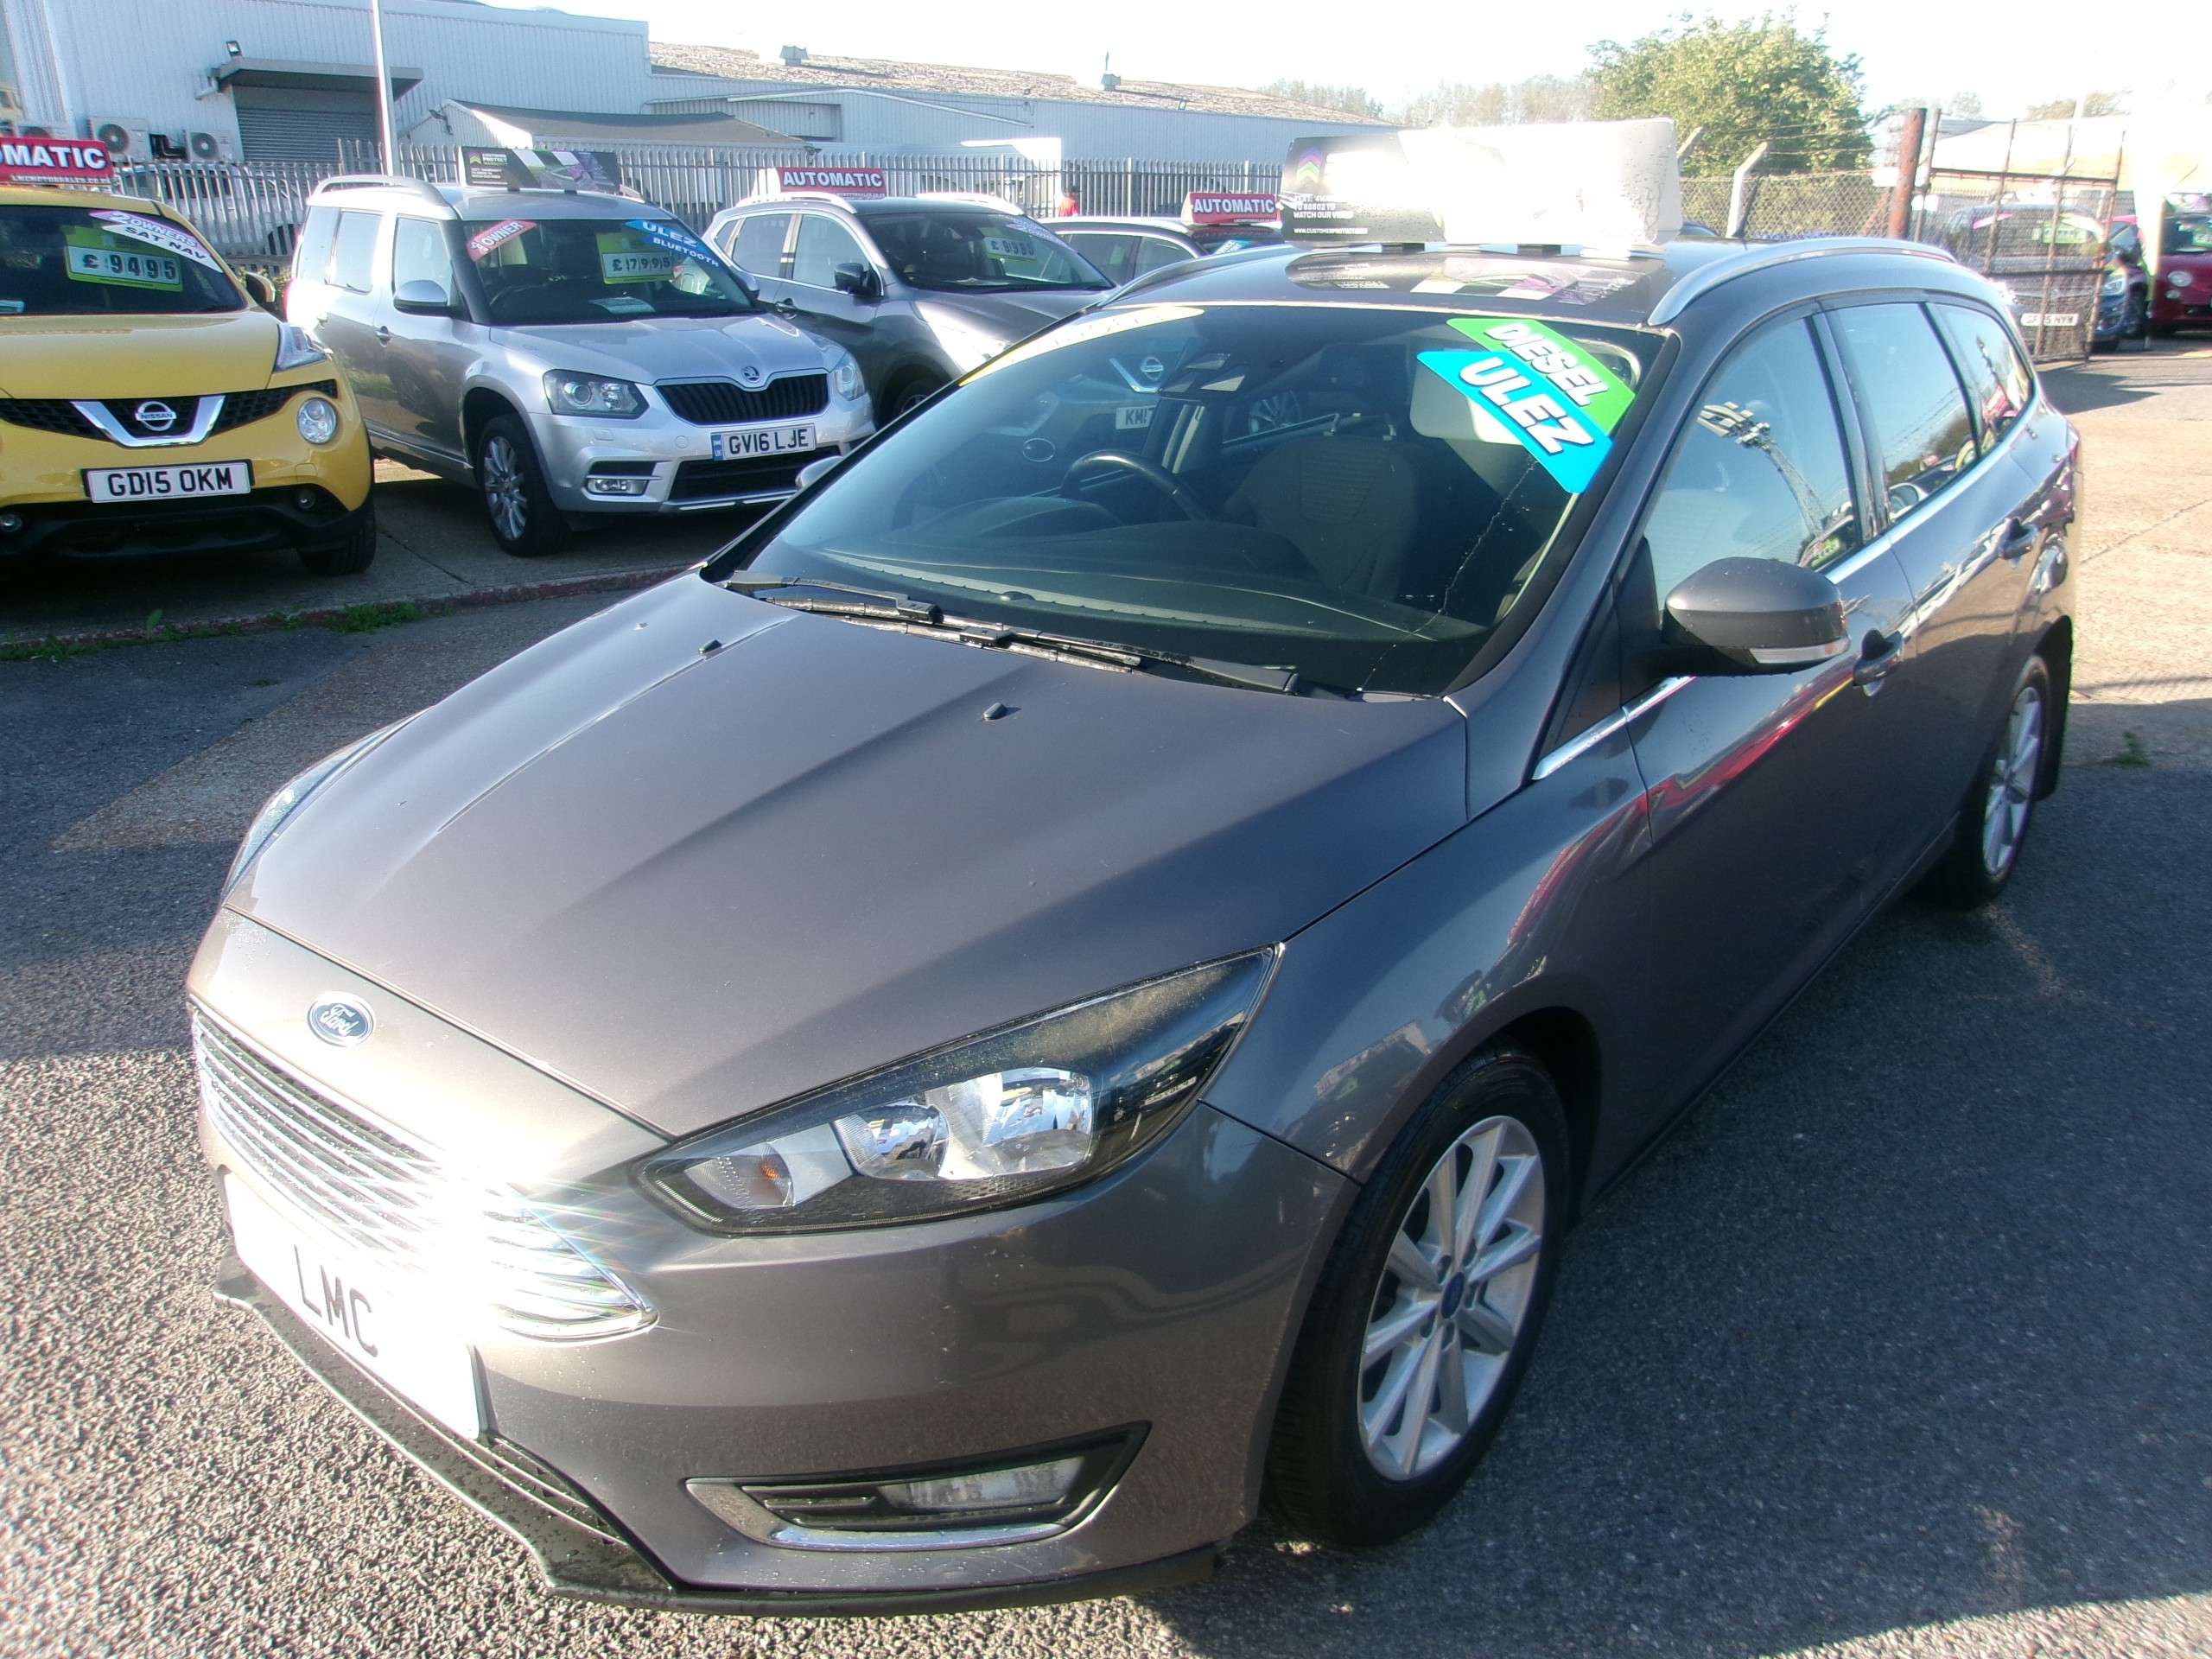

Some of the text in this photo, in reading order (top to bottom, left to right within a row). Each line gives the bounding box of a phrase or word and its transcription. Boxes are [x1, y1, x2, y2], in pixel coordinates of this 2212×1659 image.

[0, 144, 105, 169] MATIC
[784, 171, 882, 187] AUTOMATIC
[1194, 199, 1274, 213] AUTOMATIC
[124, 226, 207, 259] SAT NAV
[130, 218, 198, 246] OWNERS
[481, 221, 524, 245] OWNER
[642, 221, 697, 247] ULEZ
[653, 238, 719, 267] BLUETOOTH
[1484, 323, 1610, 407] DIESEL
[1459, 357, 1594, 455] ULEZ
[729, 433, 770, 454] GV16
[775, 429, 809, 450] LJE
[108, 467, 232, 496] GD15 OKM
[320, 1004, 359, 1037] Ford
[294, 1244, 378, 1357] LMC
